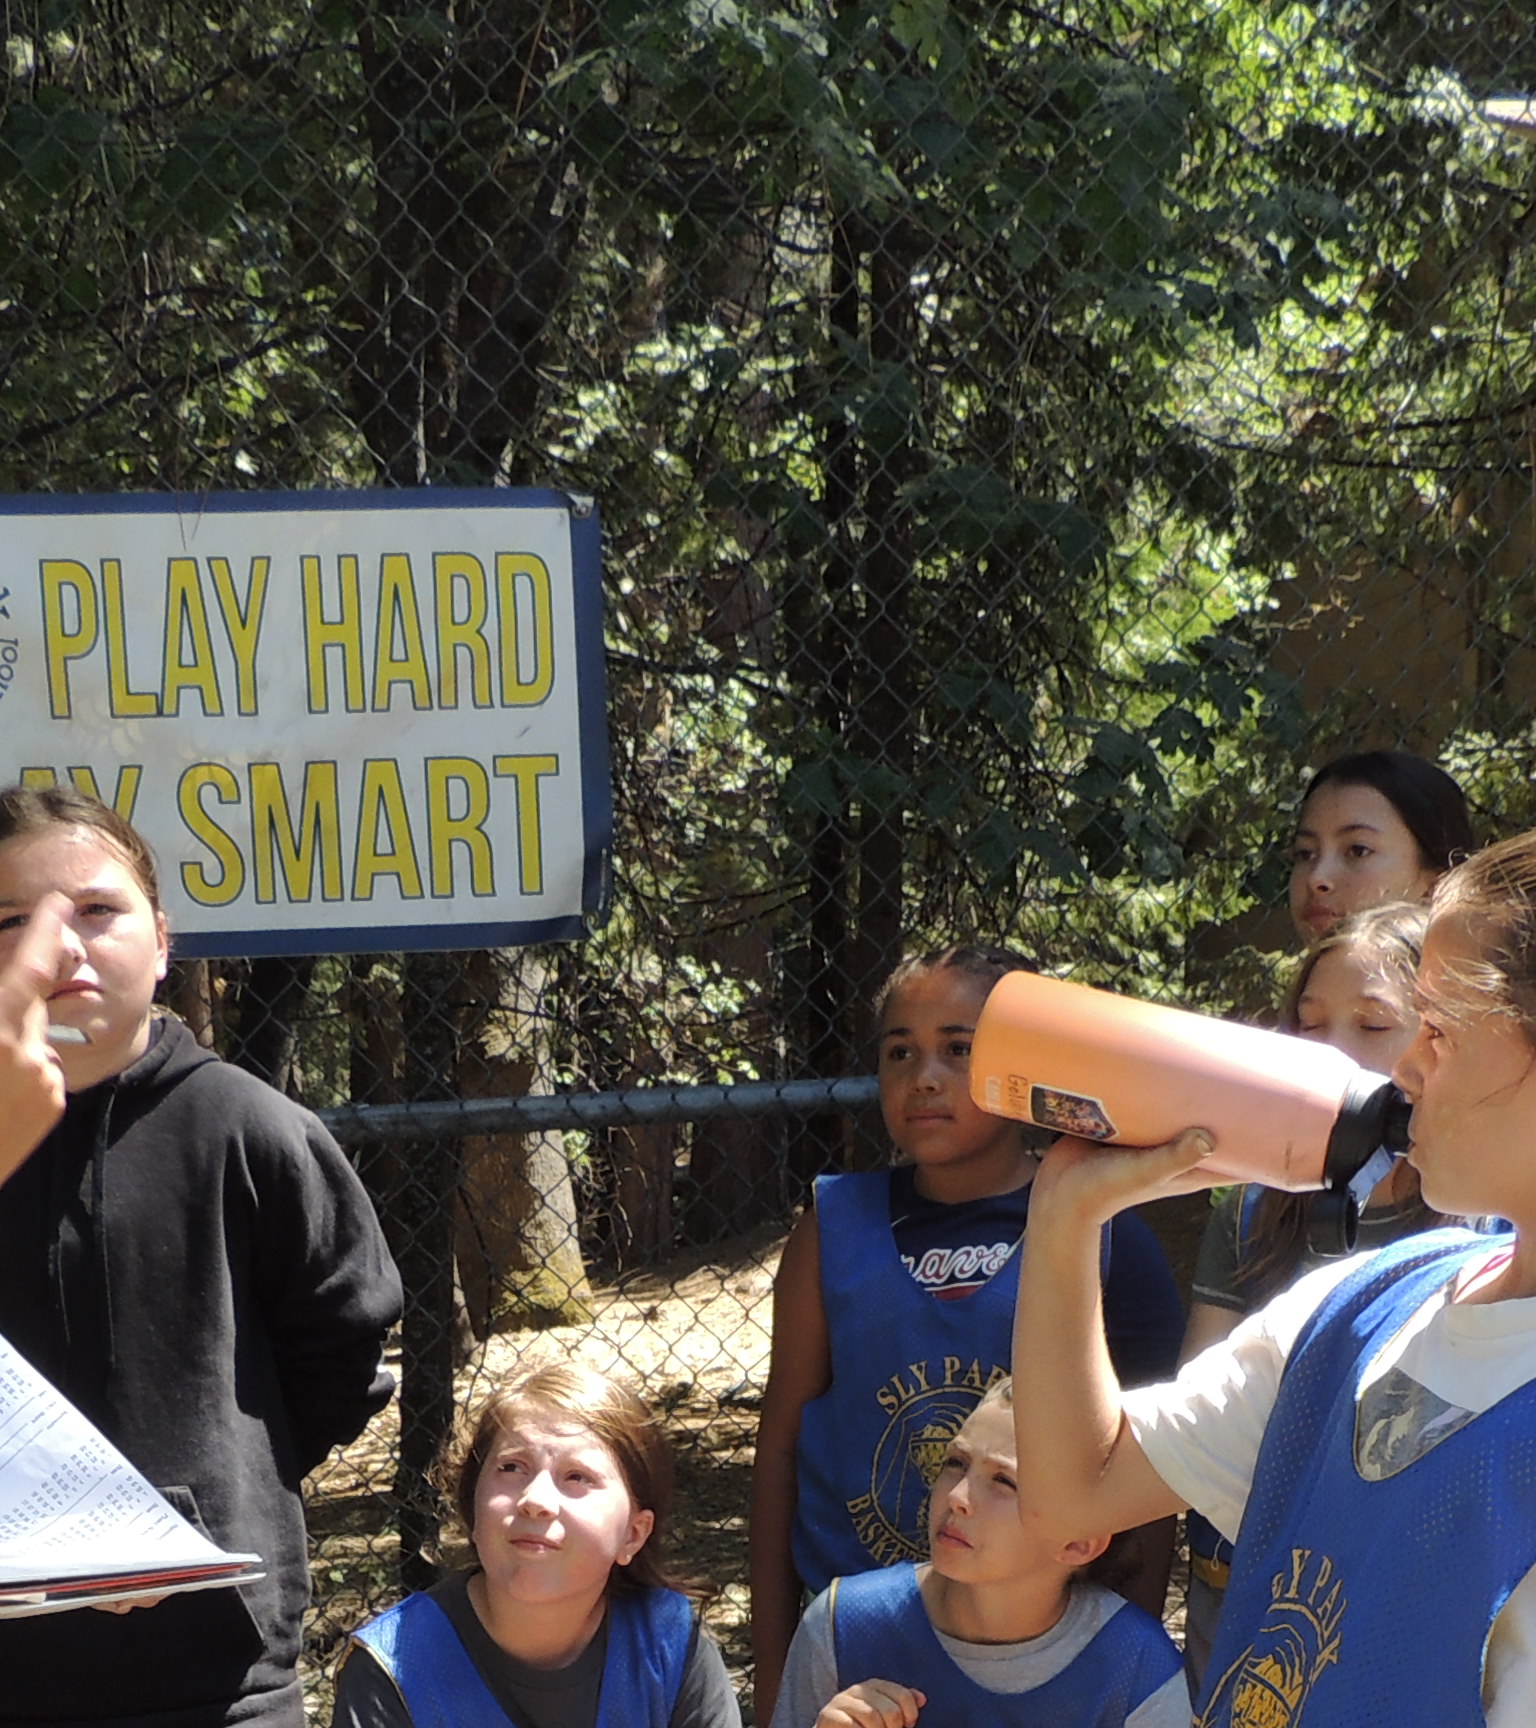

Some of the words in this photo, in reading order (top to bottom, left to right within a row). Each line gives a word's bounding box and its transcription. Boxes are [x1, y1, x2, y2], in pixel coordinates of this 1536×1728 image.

[39, 555, 271, 720] PLAY
[300, 551, 555, 714] HARD
[178, 753, 559, 907] SMART
[900, 1243, 1013, 1284] rave
[876, 1360, 931, 1415] SLY
[943, 1356, 1009, 1393] PAR
